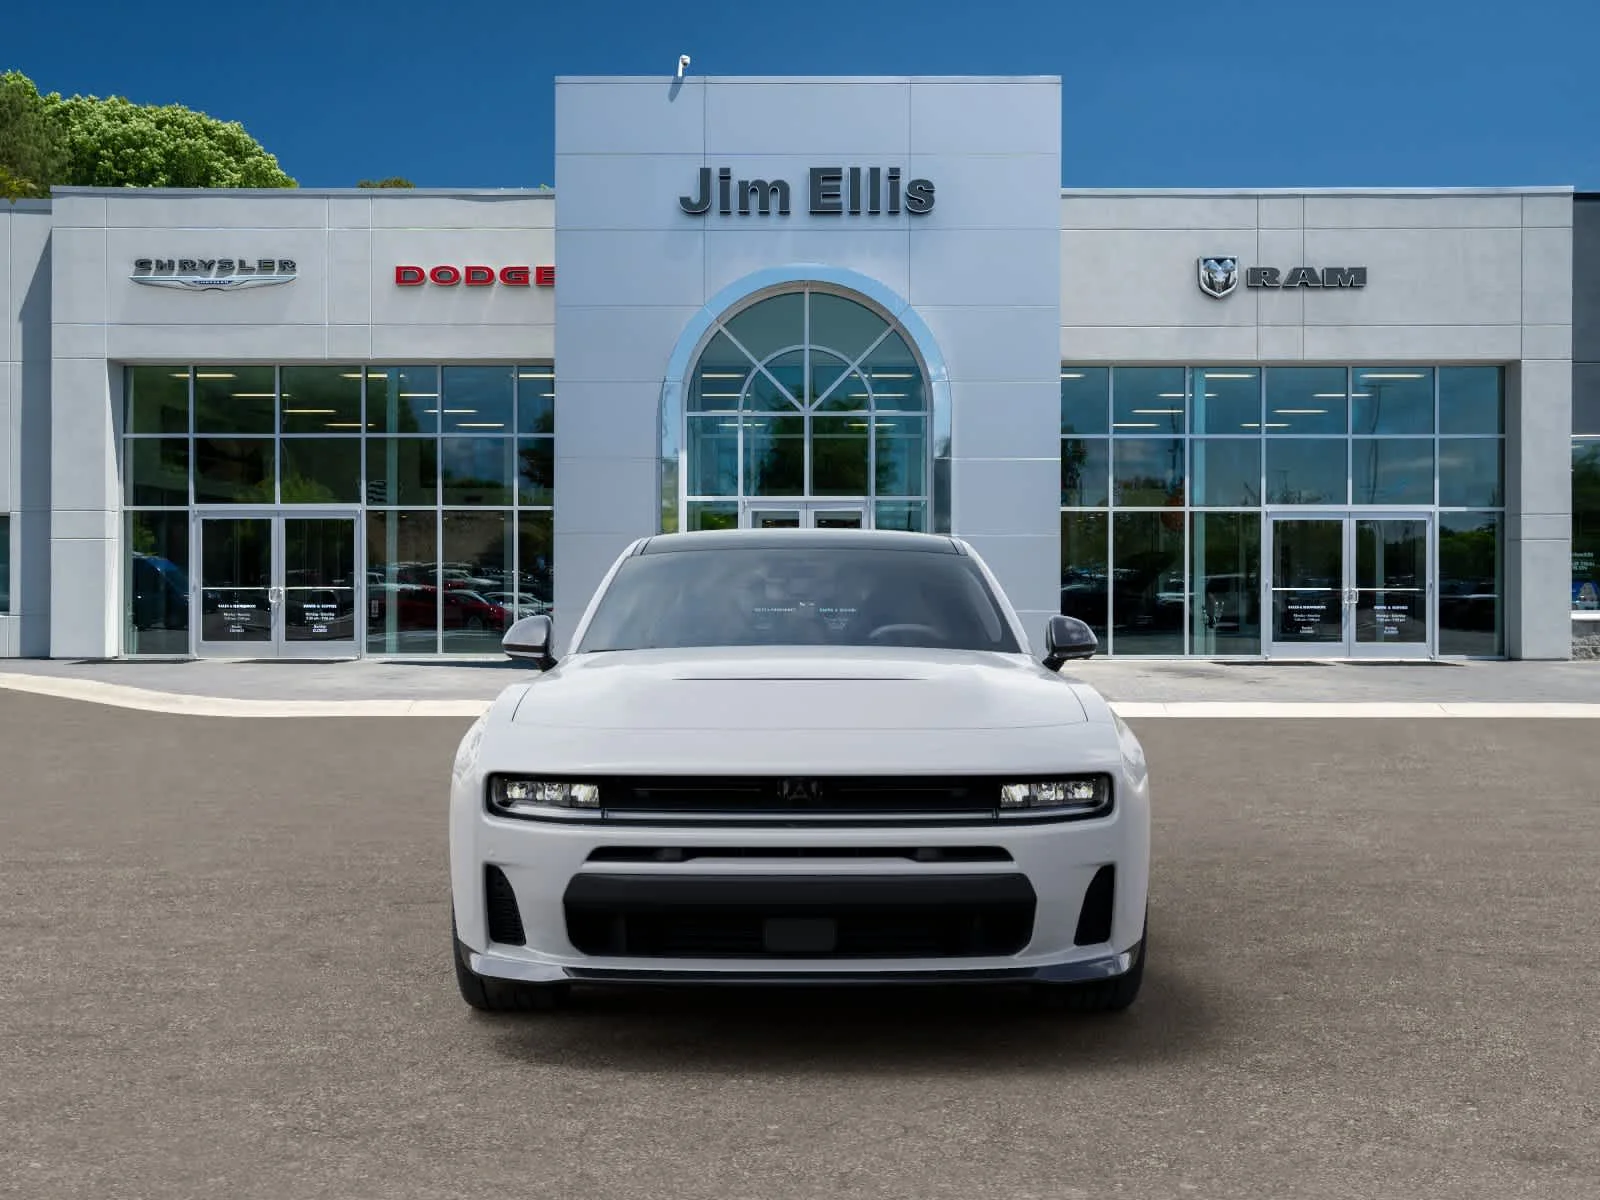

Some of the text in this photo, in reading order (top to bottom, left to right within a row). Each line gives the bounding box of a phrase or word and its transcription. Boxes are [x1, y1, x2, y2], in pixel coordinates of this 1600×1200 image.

[679, 167, 936, 214] Jim Ellis
[134, 258, 297, 273] CHRYSLER
[395, 265, 555, 286] DODGE
[1246, 266, 1367, 287] RAM
